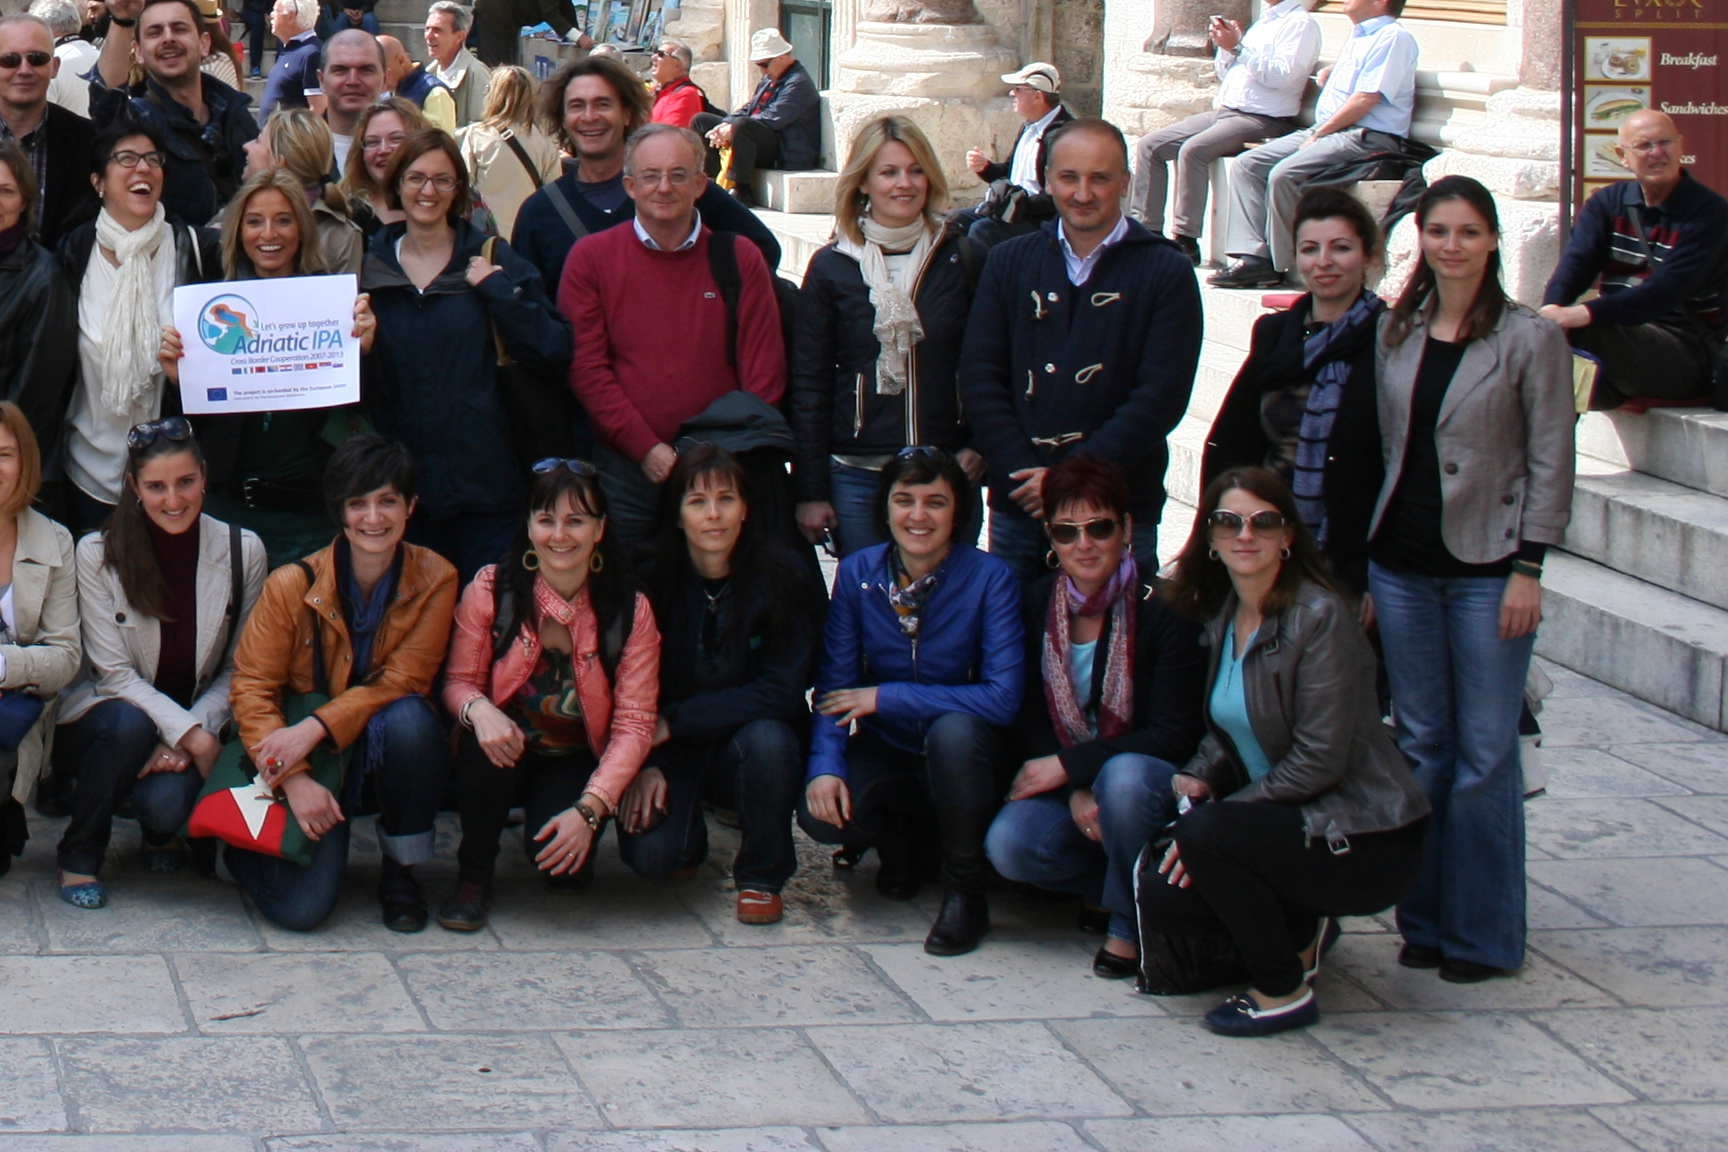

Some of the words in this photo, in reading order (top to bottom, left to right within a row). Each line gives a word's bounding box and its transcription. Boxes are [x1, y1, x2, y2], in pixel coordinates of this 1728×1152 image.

[1614, 9, 1700, 18] SPLIT
[1659, 52, 1718, 70] Breakfast
[1660, 101, 1728, 115] Sandwiches
[278, 322, 295, 331] grow
[297, 322, 306, 330] up
[308, 319, 340, 329] together
[232, 332, 309, 355] Adriatic
[311, 329, 343, 350] IPA
